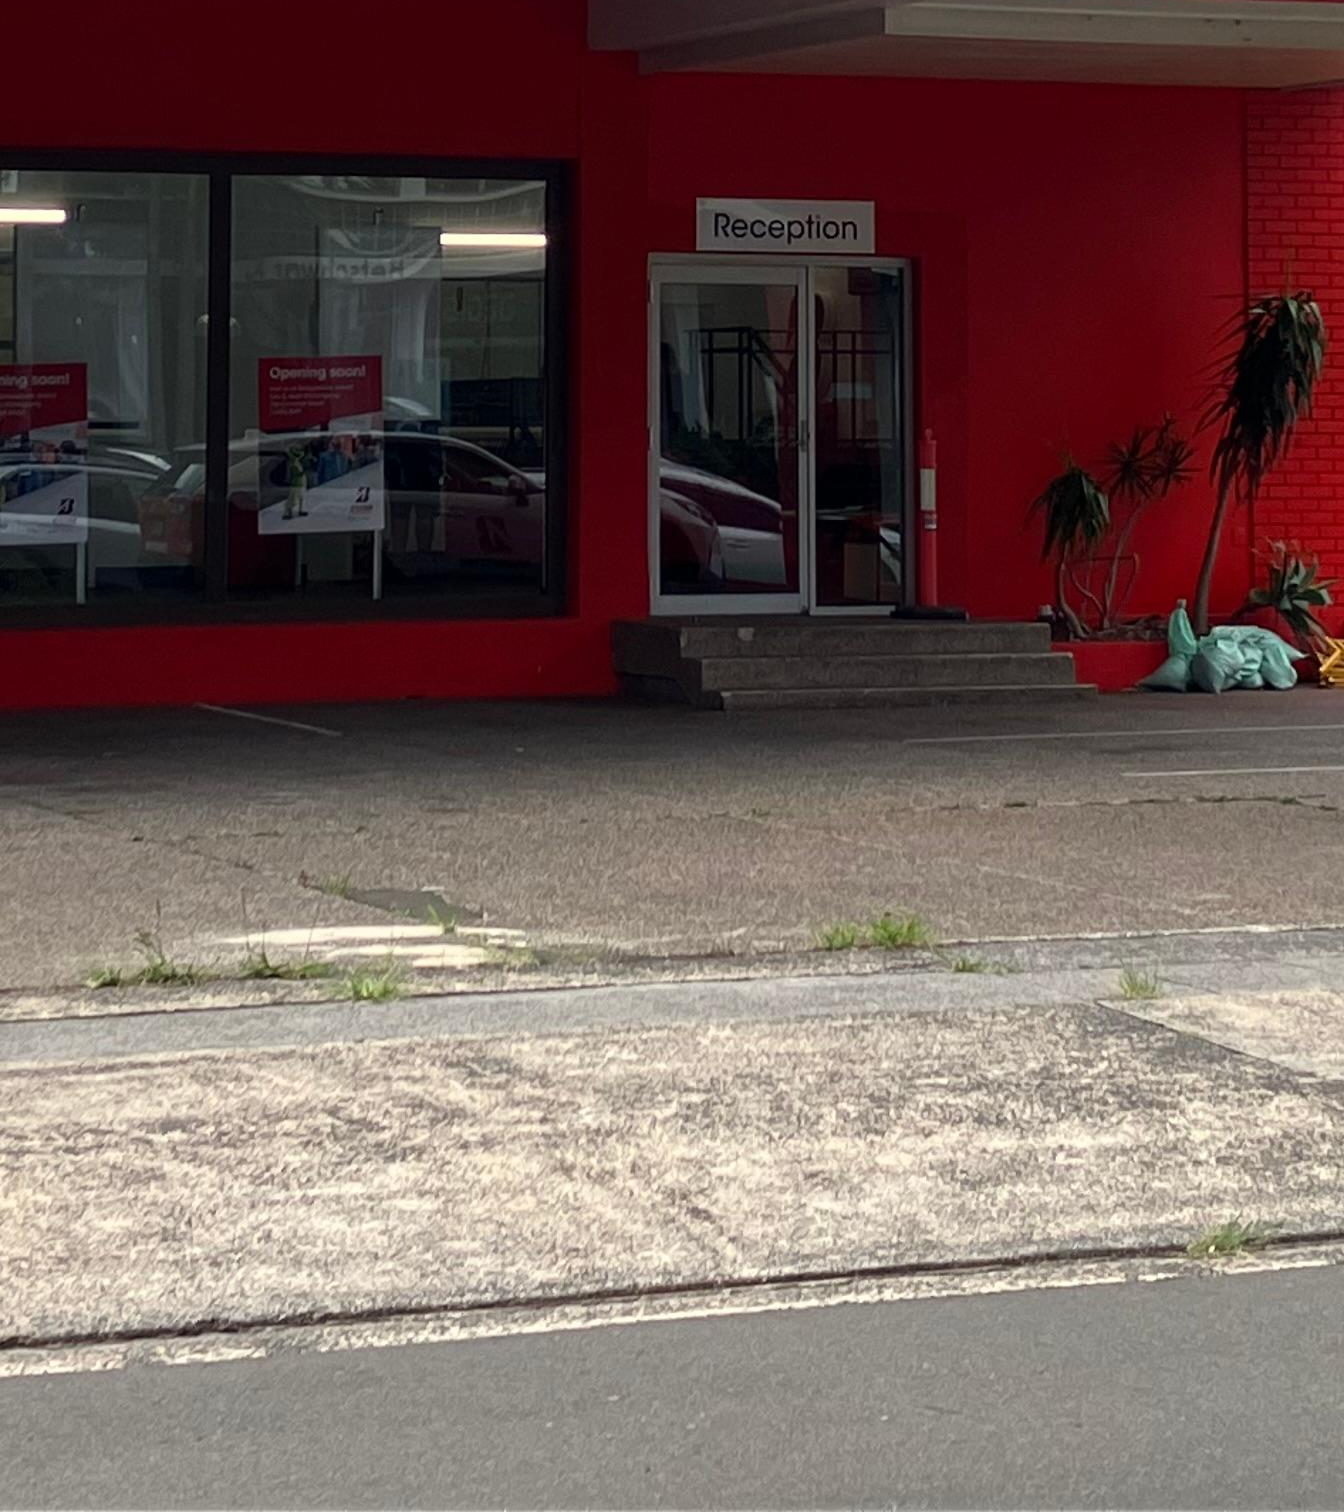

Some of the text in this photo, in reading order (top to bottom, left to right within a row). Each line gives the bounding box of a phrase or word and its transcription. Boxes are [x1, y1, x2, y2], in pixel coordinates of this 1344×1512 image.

[713, 211, 858, 246] Reception
[31, 373, 70, 386] soon!
[269, 364, 366, 381] Opening soon!
